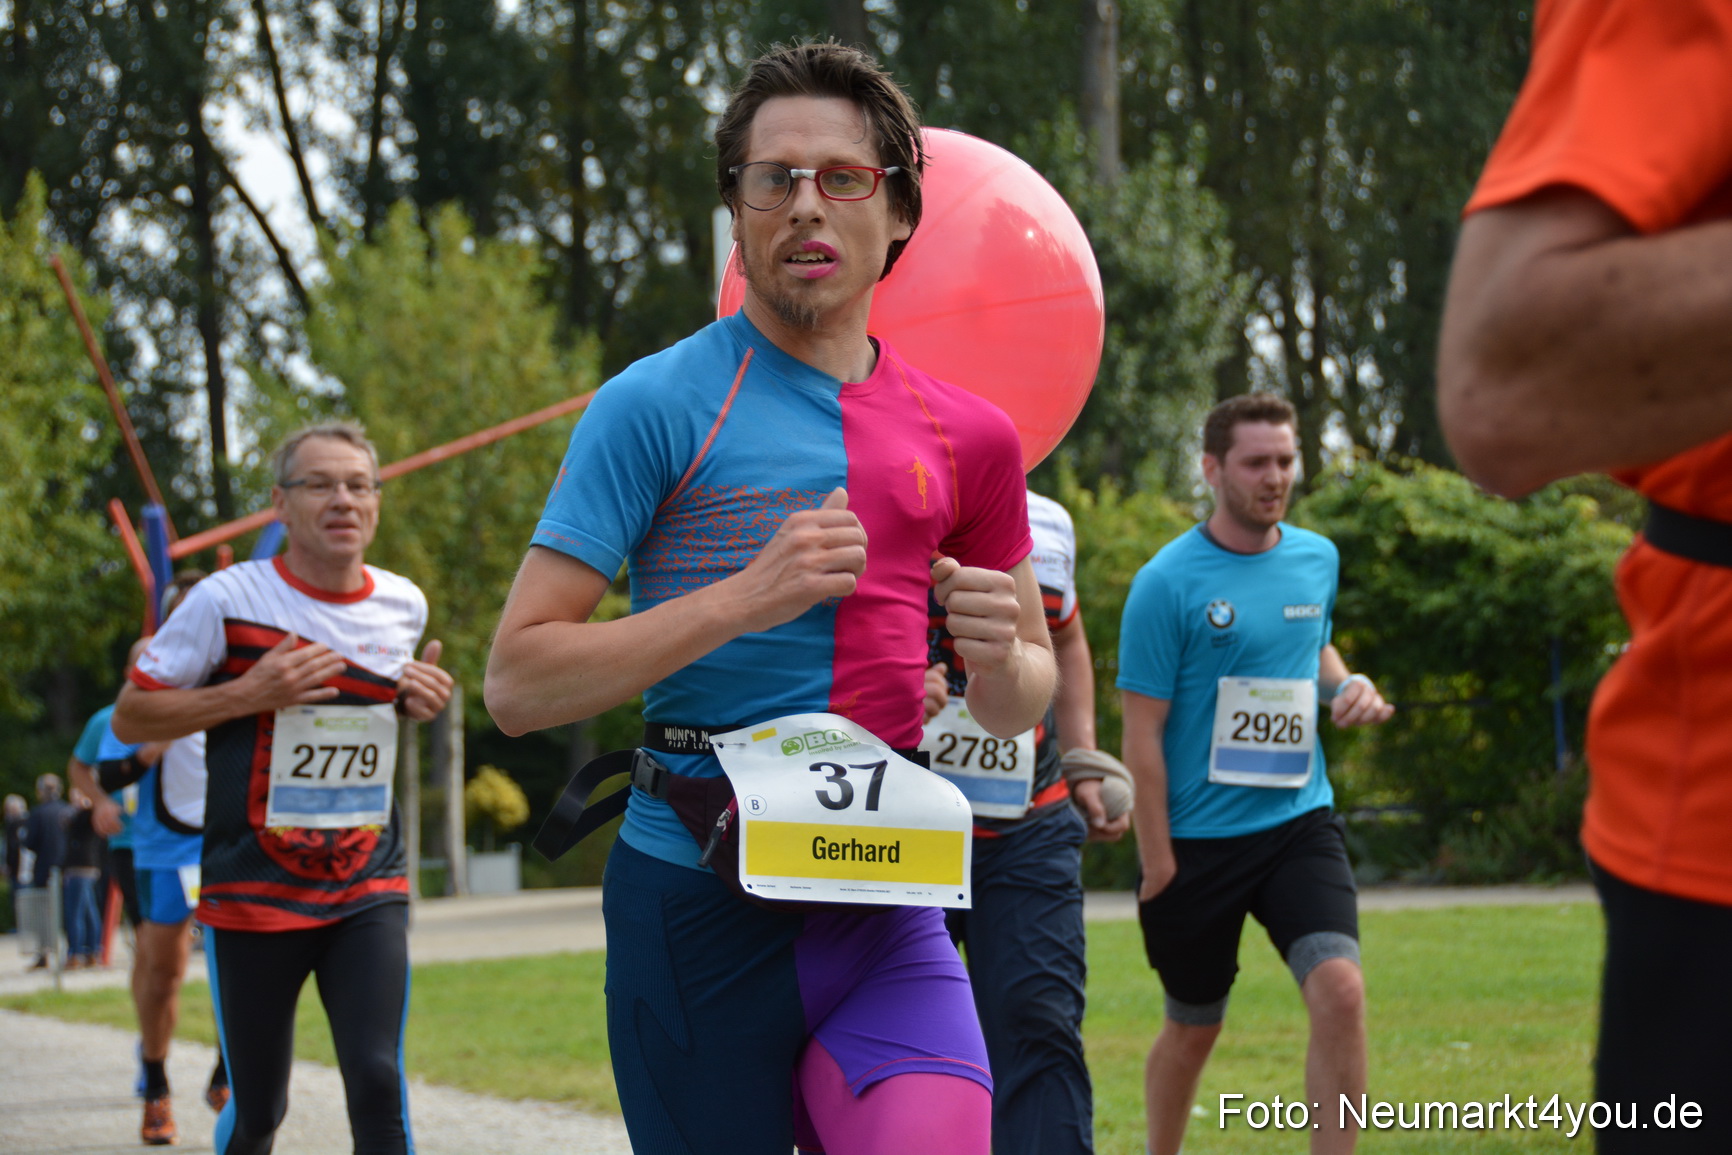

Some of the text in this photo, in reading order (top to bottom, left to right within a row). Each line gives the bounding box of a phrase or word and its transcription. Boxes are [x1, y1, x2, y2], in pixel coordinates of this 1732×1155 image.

[1231, 711, 1303, 744] 2926
[291, 743, 380, 780] 2779
[935, 733, 1018, 772] 2783
[809, 759, 888, 812] 37
[751, 799, 760, 811] B
[812, 836, 901, 864] Gerhard
